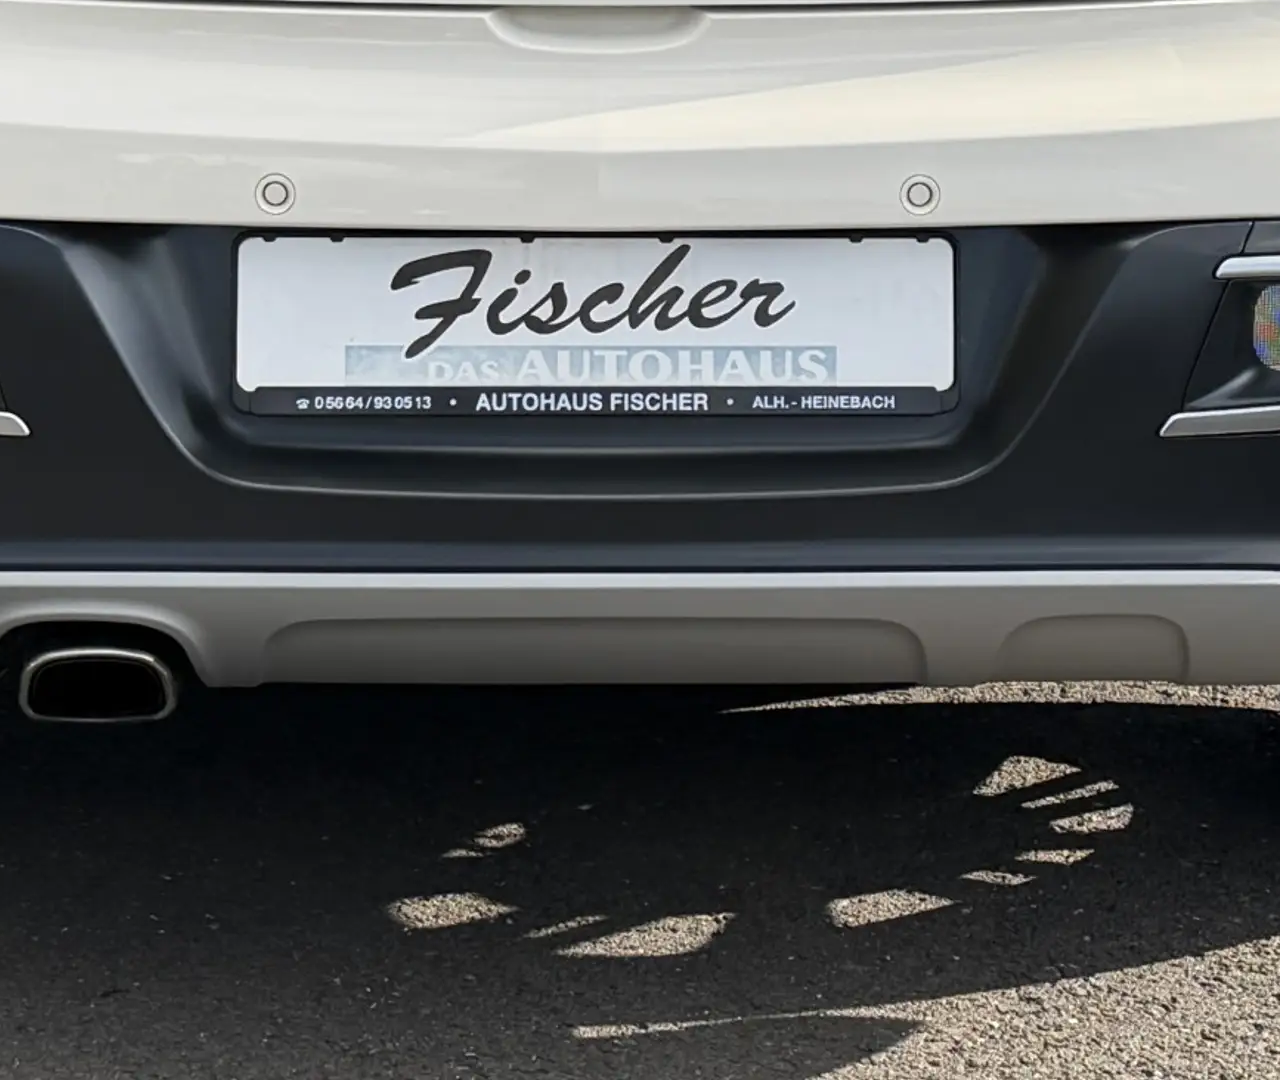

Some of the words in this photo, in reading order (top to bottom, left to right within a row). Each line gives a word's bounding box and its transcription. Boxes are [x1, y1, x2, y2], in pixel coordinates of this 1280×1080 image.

[390, 244, 795, 359] Fischer
[427, 360, 500, 383] DAS
[519, 348, 826, 383] AUTOHAUS
[475, 393, 603, 411] AUTOHAUS
[610, 393, 709, 411] FISCHER
